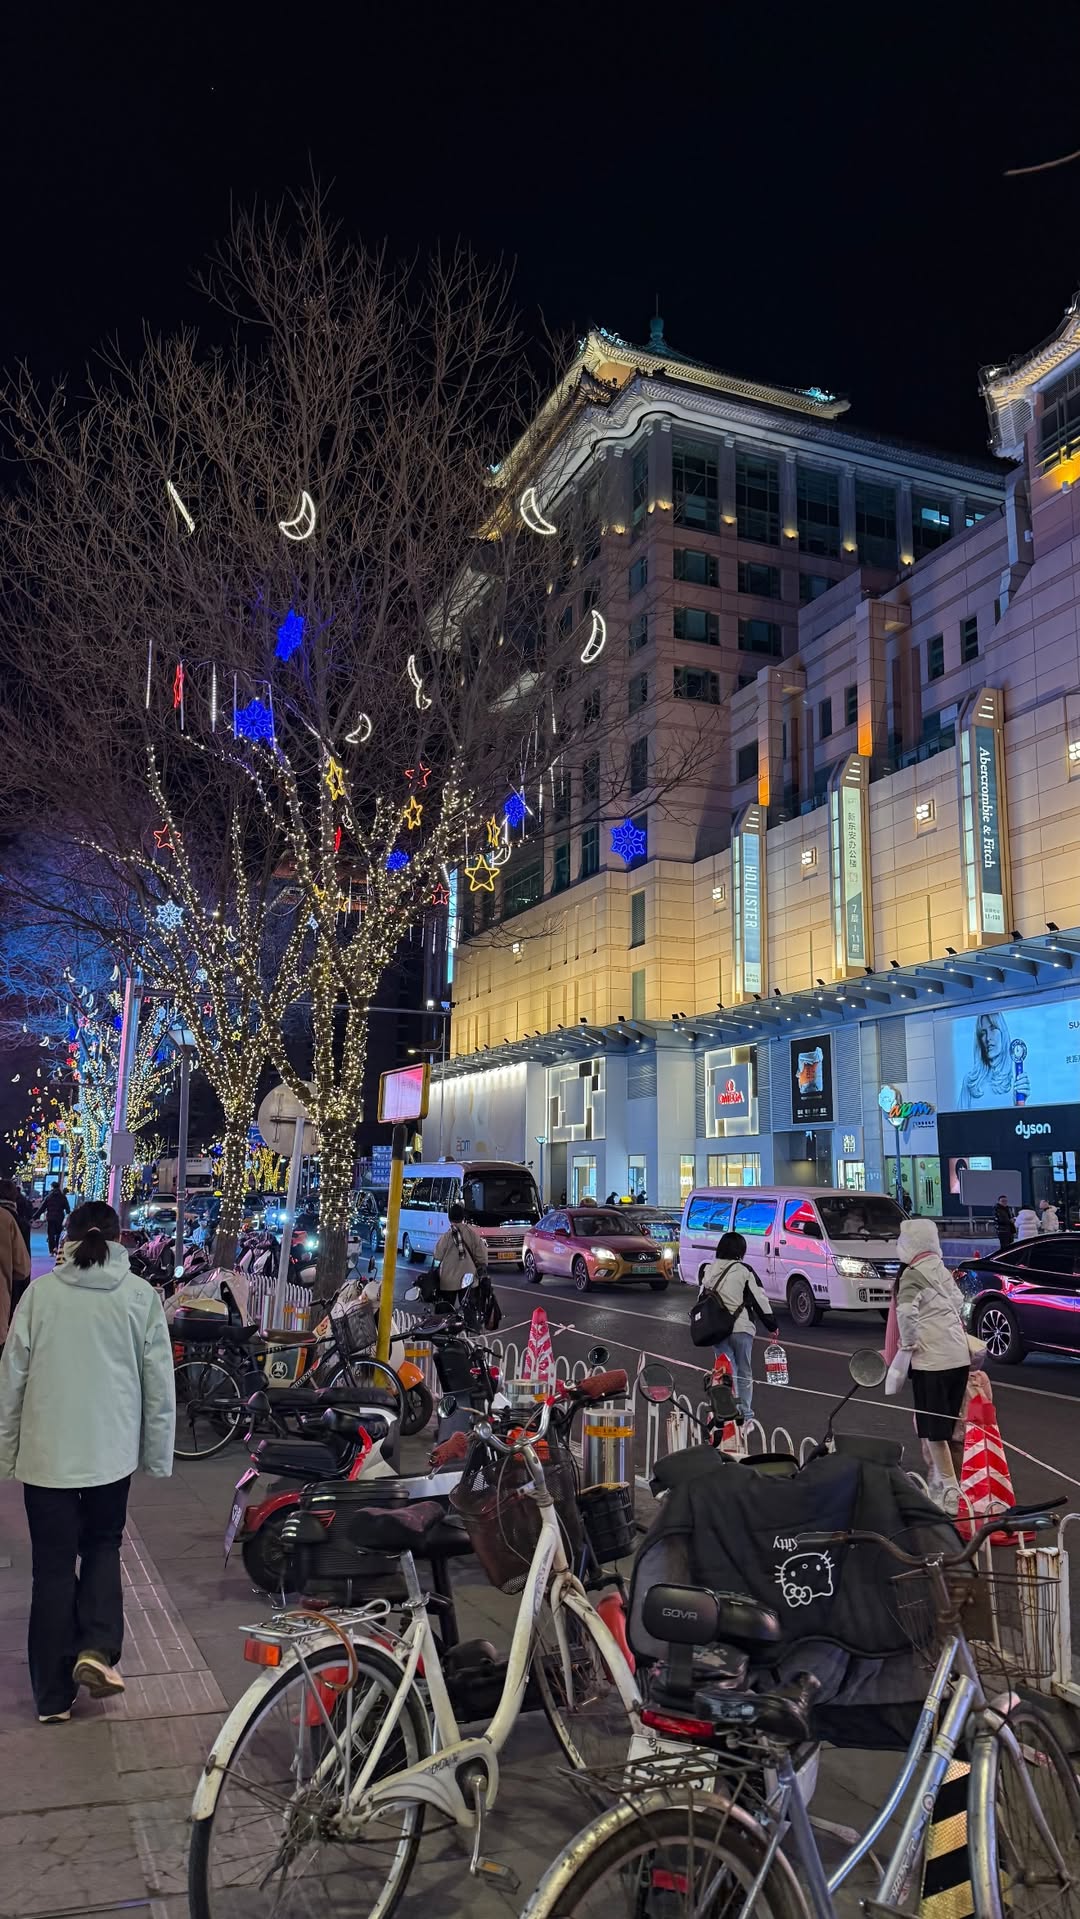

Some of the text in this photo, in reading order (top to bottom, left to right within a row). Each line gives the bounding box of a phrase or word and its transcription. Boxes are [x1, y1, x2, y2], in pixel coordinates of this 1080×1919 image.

[979, 746, 997, 868] Abercrombie & Fitch
[744, 865, 758, 928] HOLLISTER
[718, 1091, 745, 1105] OMEGA
[889, 1101, 930, 1124] apm
[1015, 1120, 1052, 1139] dyson
